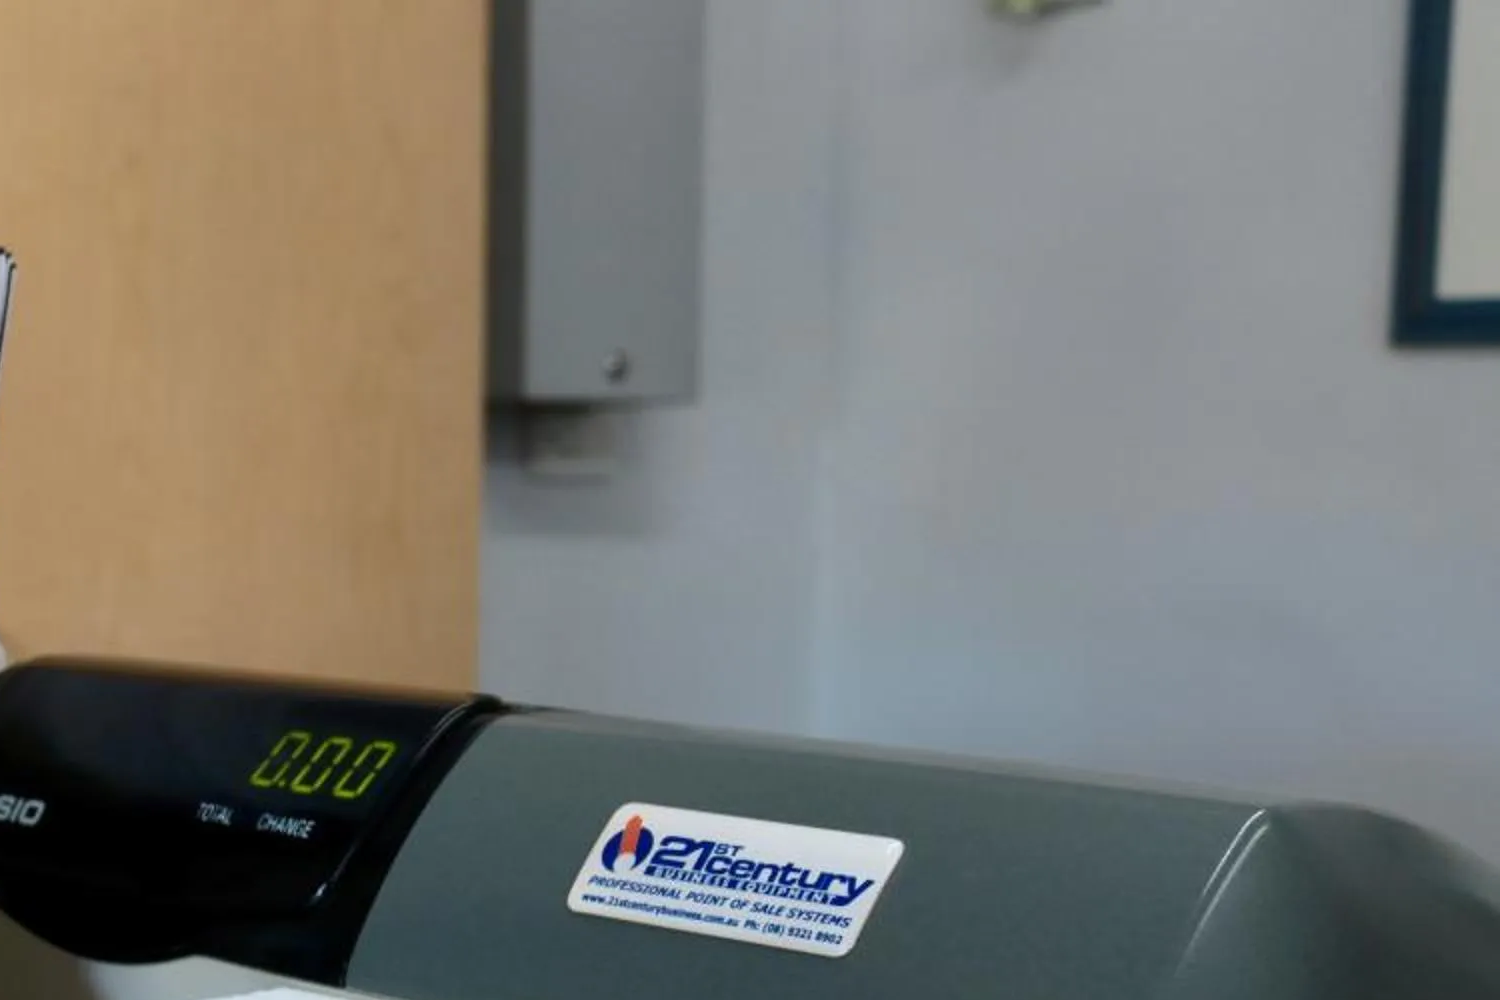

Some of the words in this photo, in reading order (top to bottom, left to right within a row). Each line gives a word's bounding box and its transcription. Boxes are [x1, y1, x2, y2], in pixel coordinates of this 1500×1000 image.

[249, 731, 397, 798] 0.00
[197, 801, 233, 827] TOTAL
[257, 812, 316, 839] CHANGE
[588, 874, 684, 901] PROFESSIONAL
[685, 890, 731, 907] POINT
[729, 898, 749, 911] OF
[751, 901, 789, 918] SALE
[787, 907, 853, 929] SYSTEMS
[704, 855, 876, 907] century
